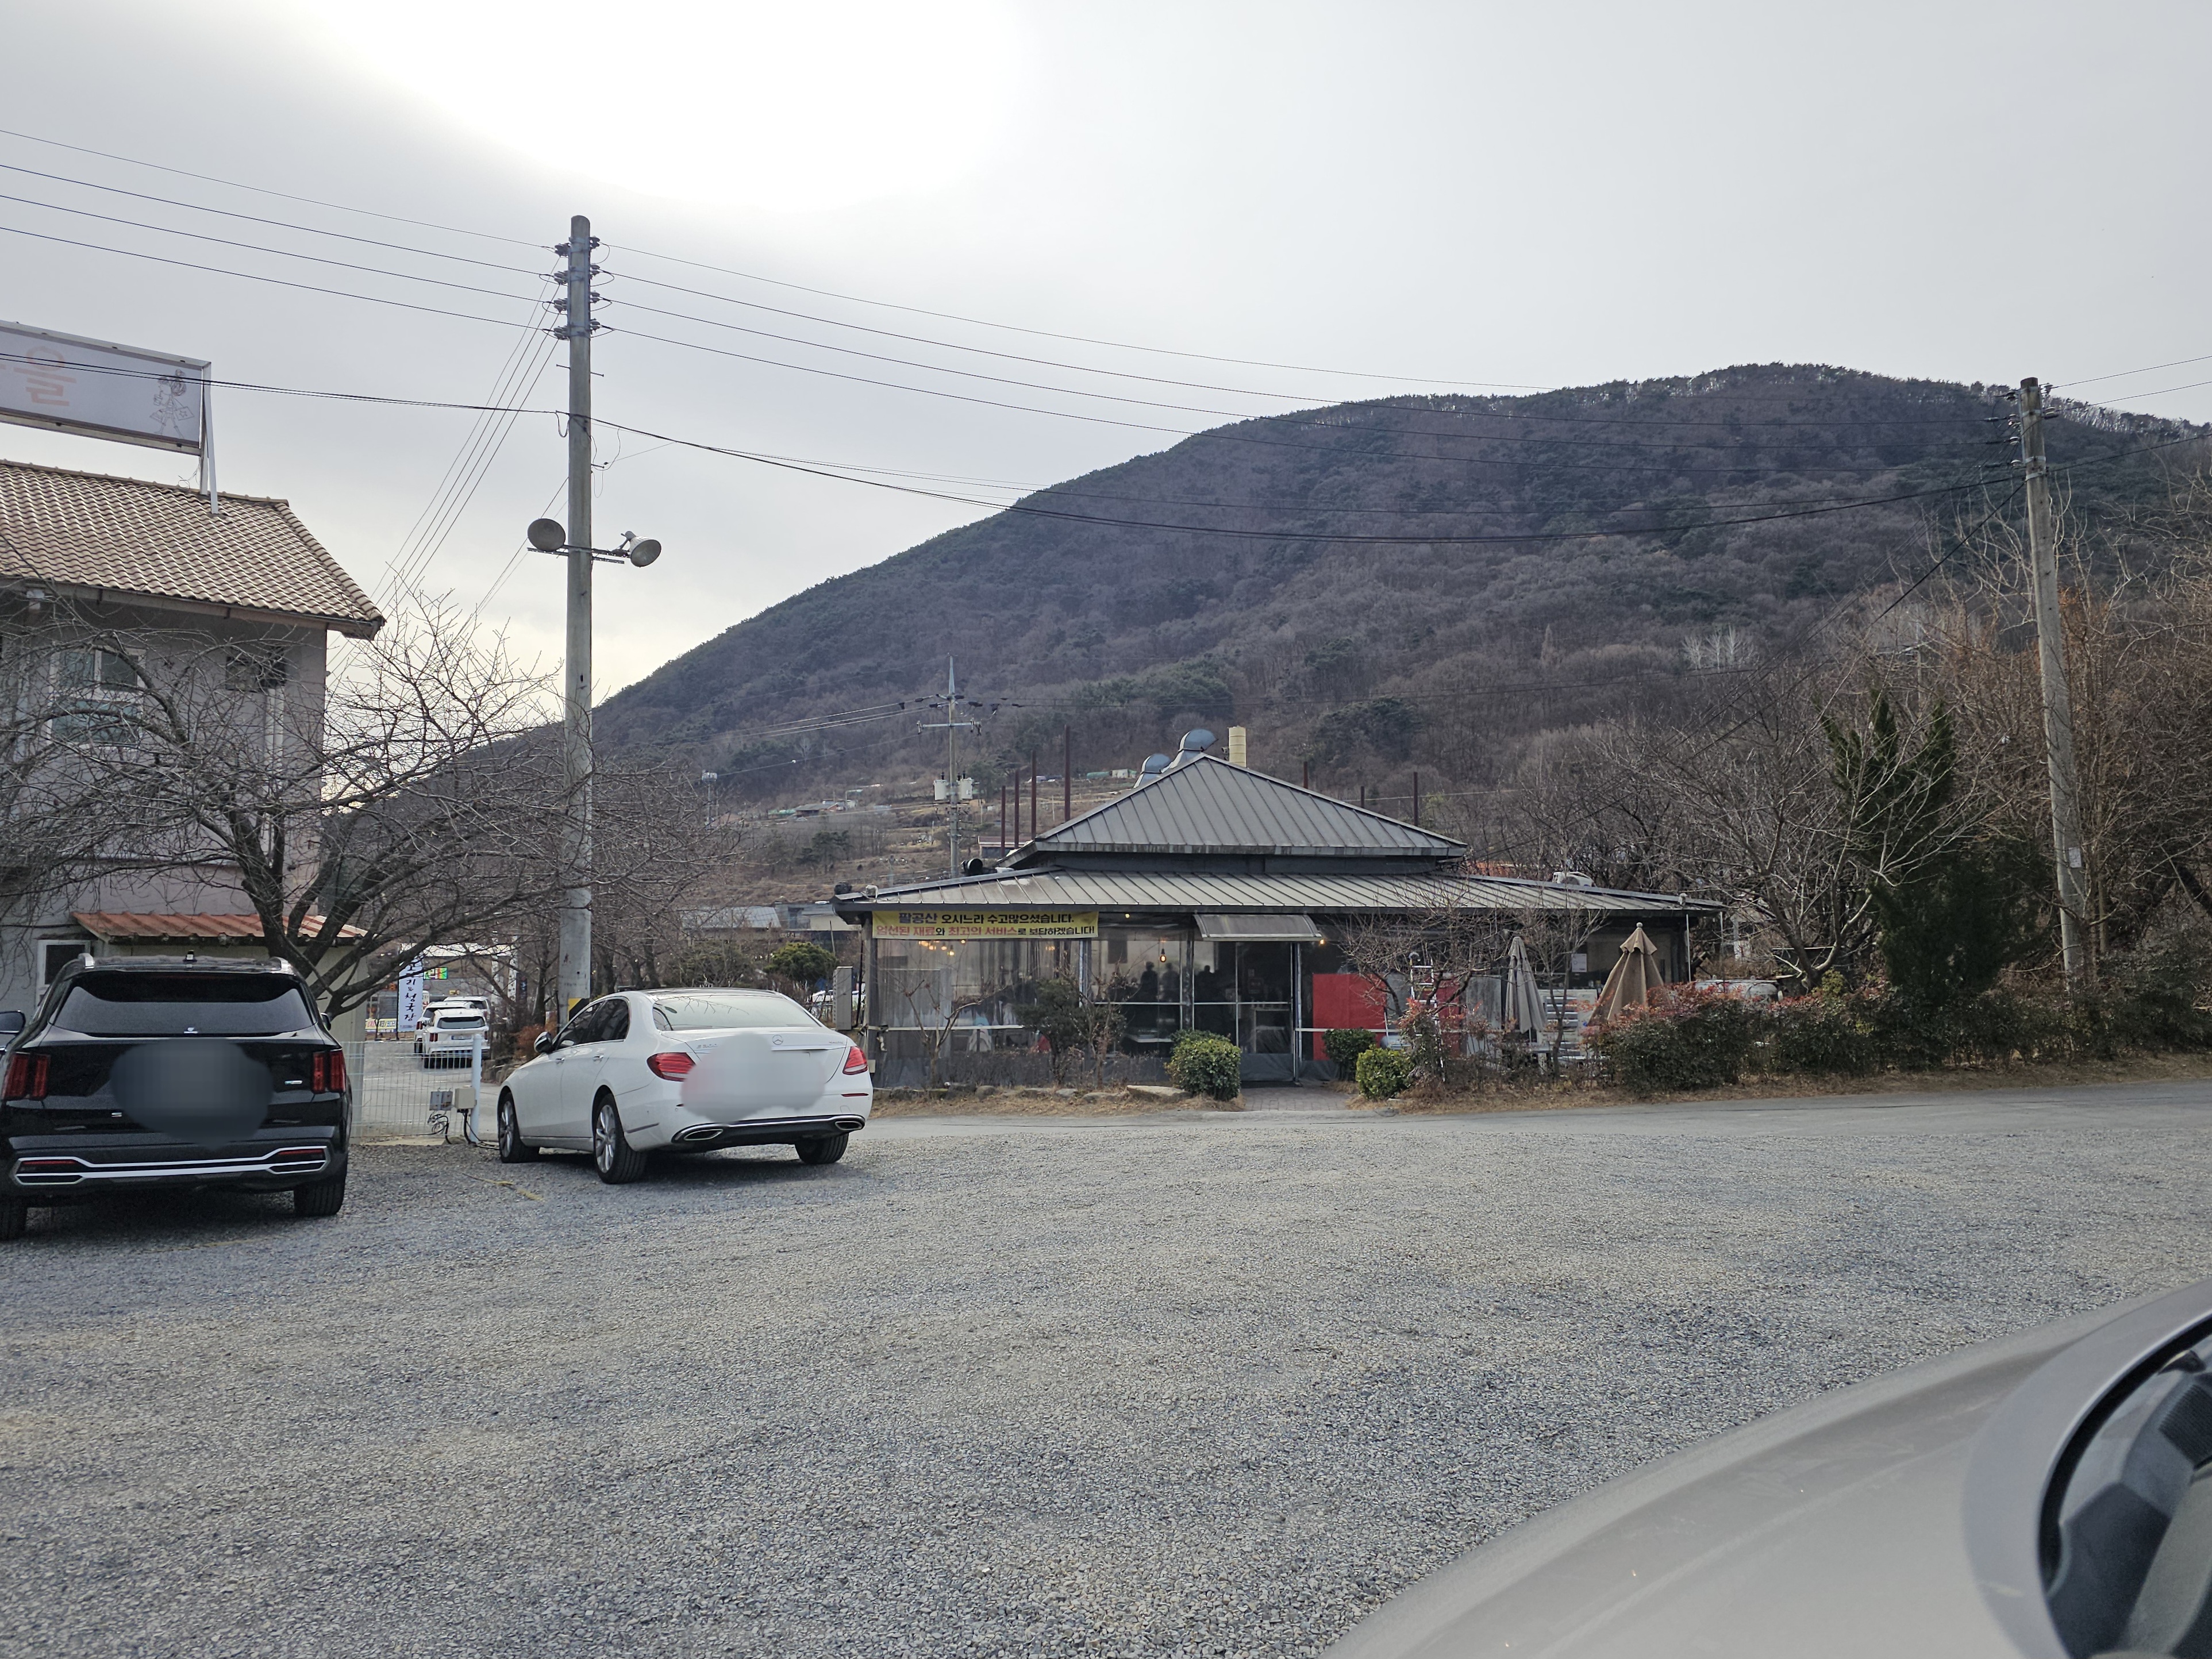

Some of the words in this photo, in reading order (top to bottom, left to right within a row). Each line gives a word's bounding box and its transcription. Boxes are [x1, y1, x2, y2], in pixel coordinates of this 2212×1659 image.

[0, 345, 77, 406] 을
[876, 925, 910, 936] 엄선된
[913, 926, 945, 936] 재료와
[948, 926, 982, 936] 최고의
[985, 926, 1026, 936] 서비스로
[1029, 926, 1095, 936] 보답하겠습니다!
[899, 913, 937, 924] 팔공산
[941, 914, 984, 924] 오시느라
[987, 914, 1075, 924] 수고많으셨습니다.
[404, 960, 417, 1022] 리&청국장
